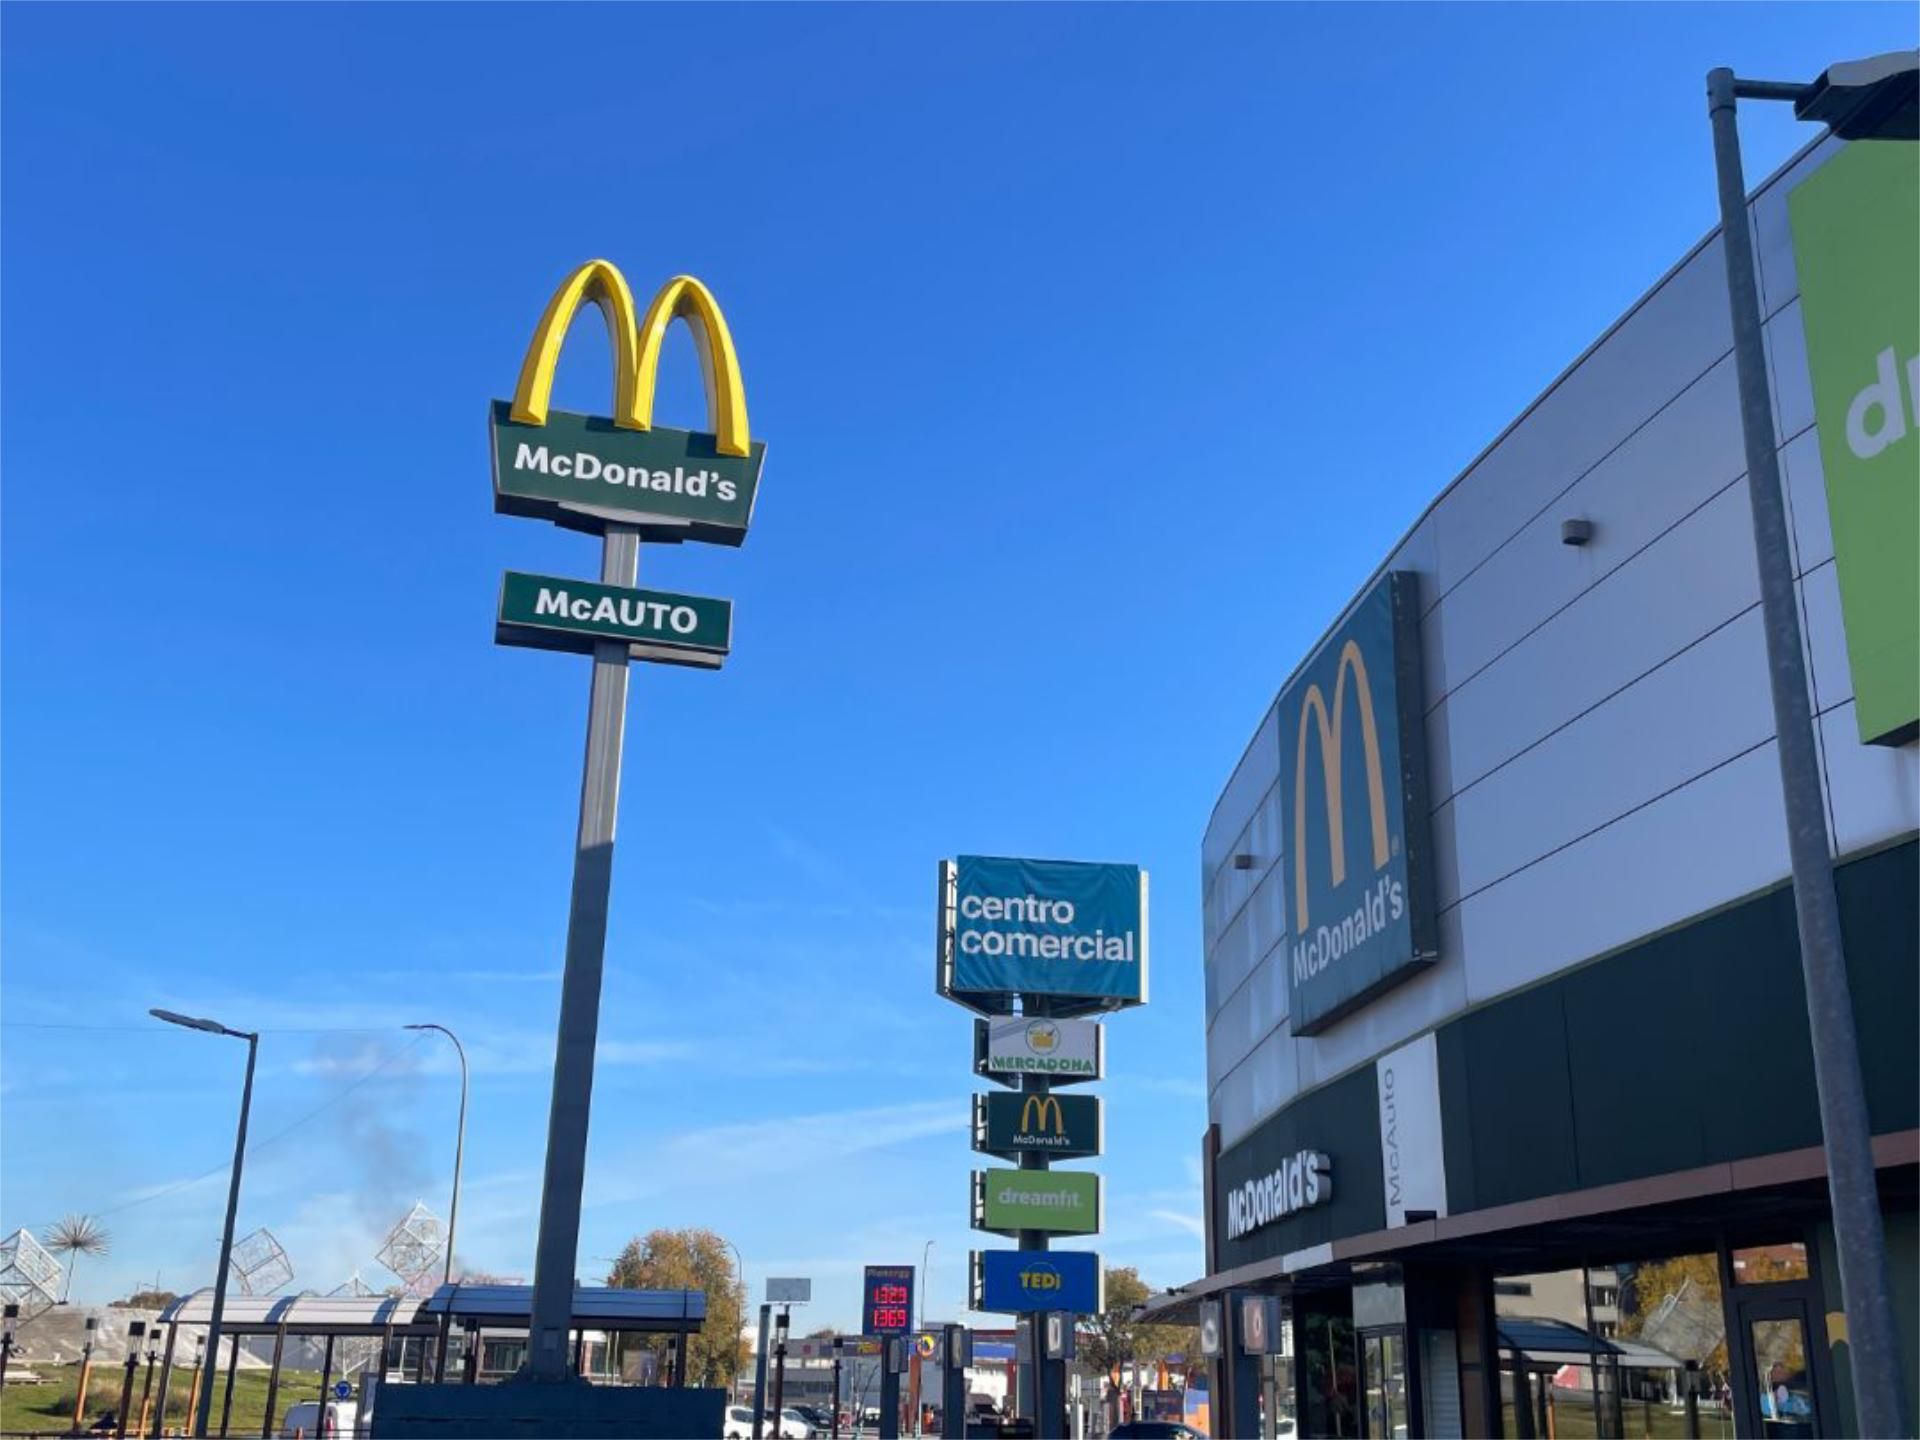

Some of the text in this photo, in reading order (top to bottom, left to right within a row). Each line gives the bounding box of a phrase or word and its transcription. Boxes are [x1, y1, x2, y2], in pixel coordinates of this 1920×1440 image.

[514, 443, 737, 502] McDonald's
[534, 587, 698, 635] McAUTO
[960, 893, 1075, 924] centro
[960, 929, 1134, 962] comercial
[1294, 874, 1403, 988] McDonald's
[991, 1055, 1093, 1072] MERCADONA
[1013, 1135, 1070, 1146] McDonald's
[1227, 1149, 1322, 1240] McDonald's
